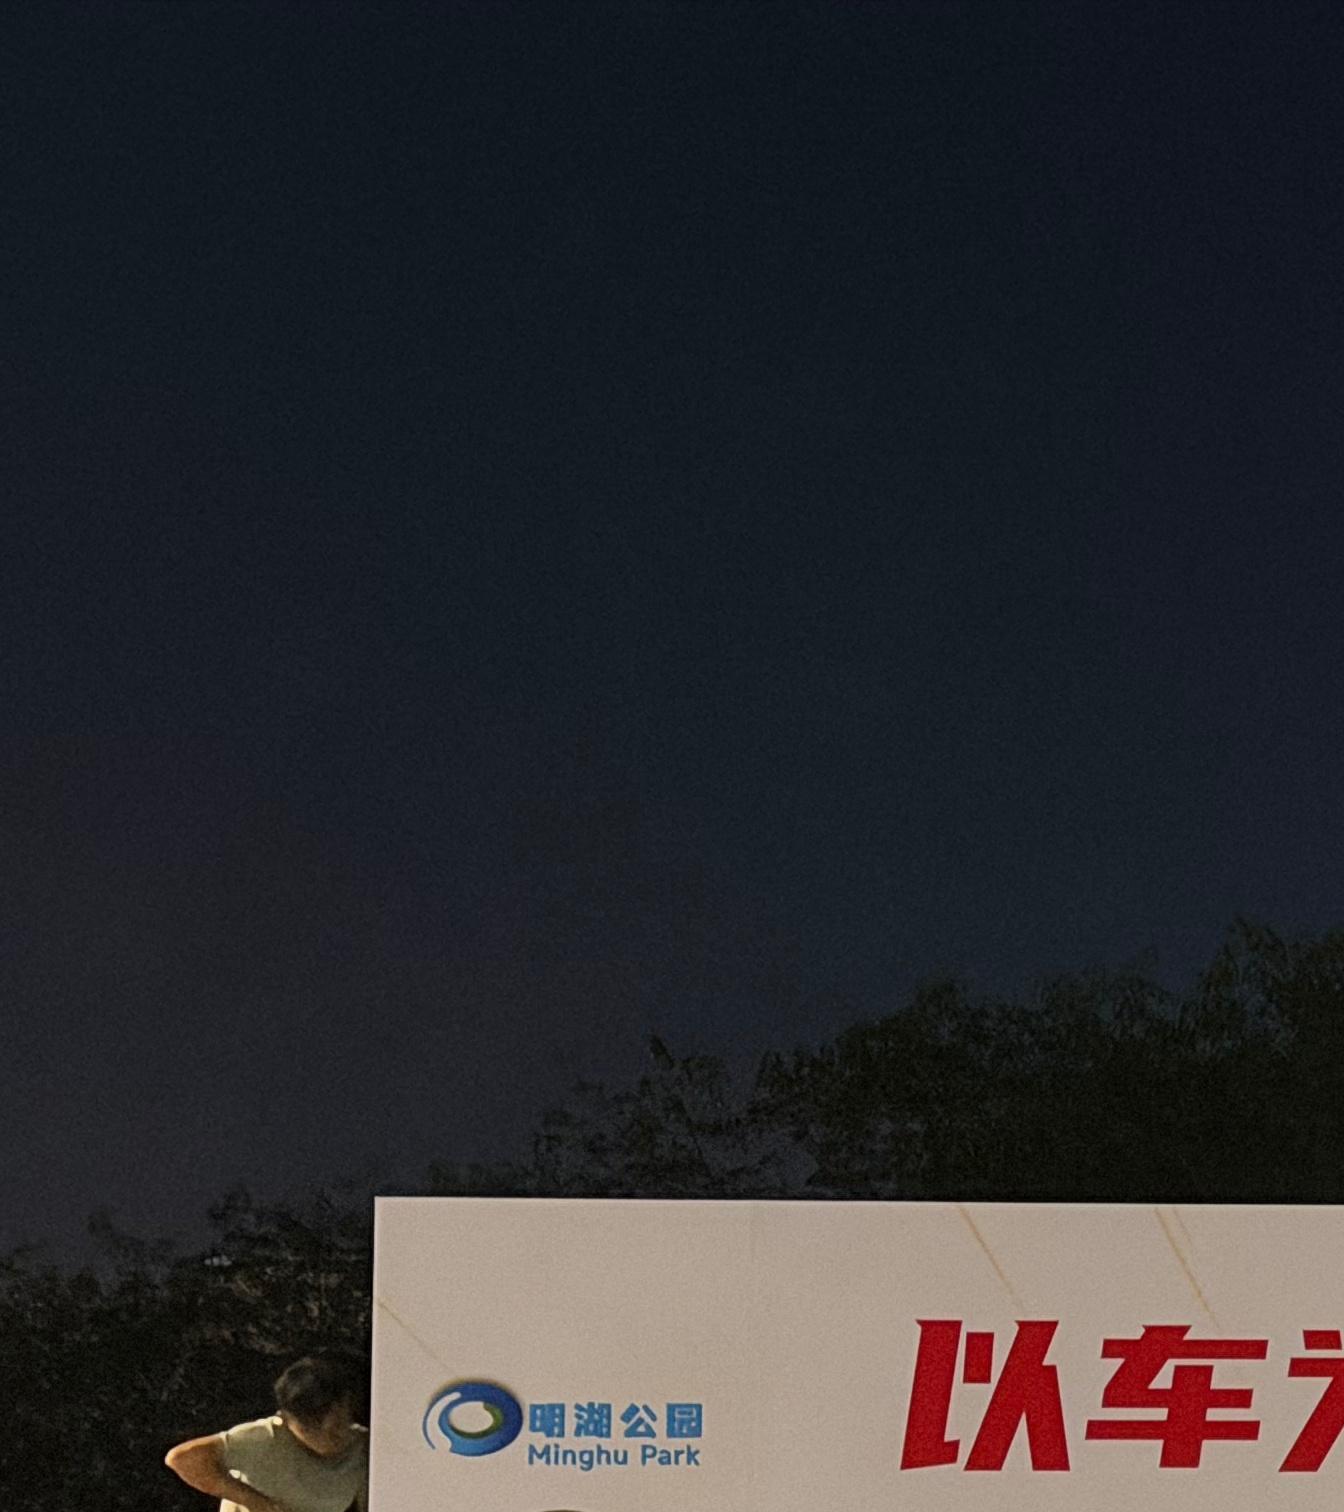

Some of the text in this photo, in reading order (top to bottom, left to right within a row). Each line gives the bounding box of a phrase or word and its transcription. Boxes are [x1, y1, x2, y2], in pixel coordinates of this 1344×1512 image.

[528, 1402, 703, 1439] 明湖公园
[528, 1444, 700, 1471] Minghu Park
